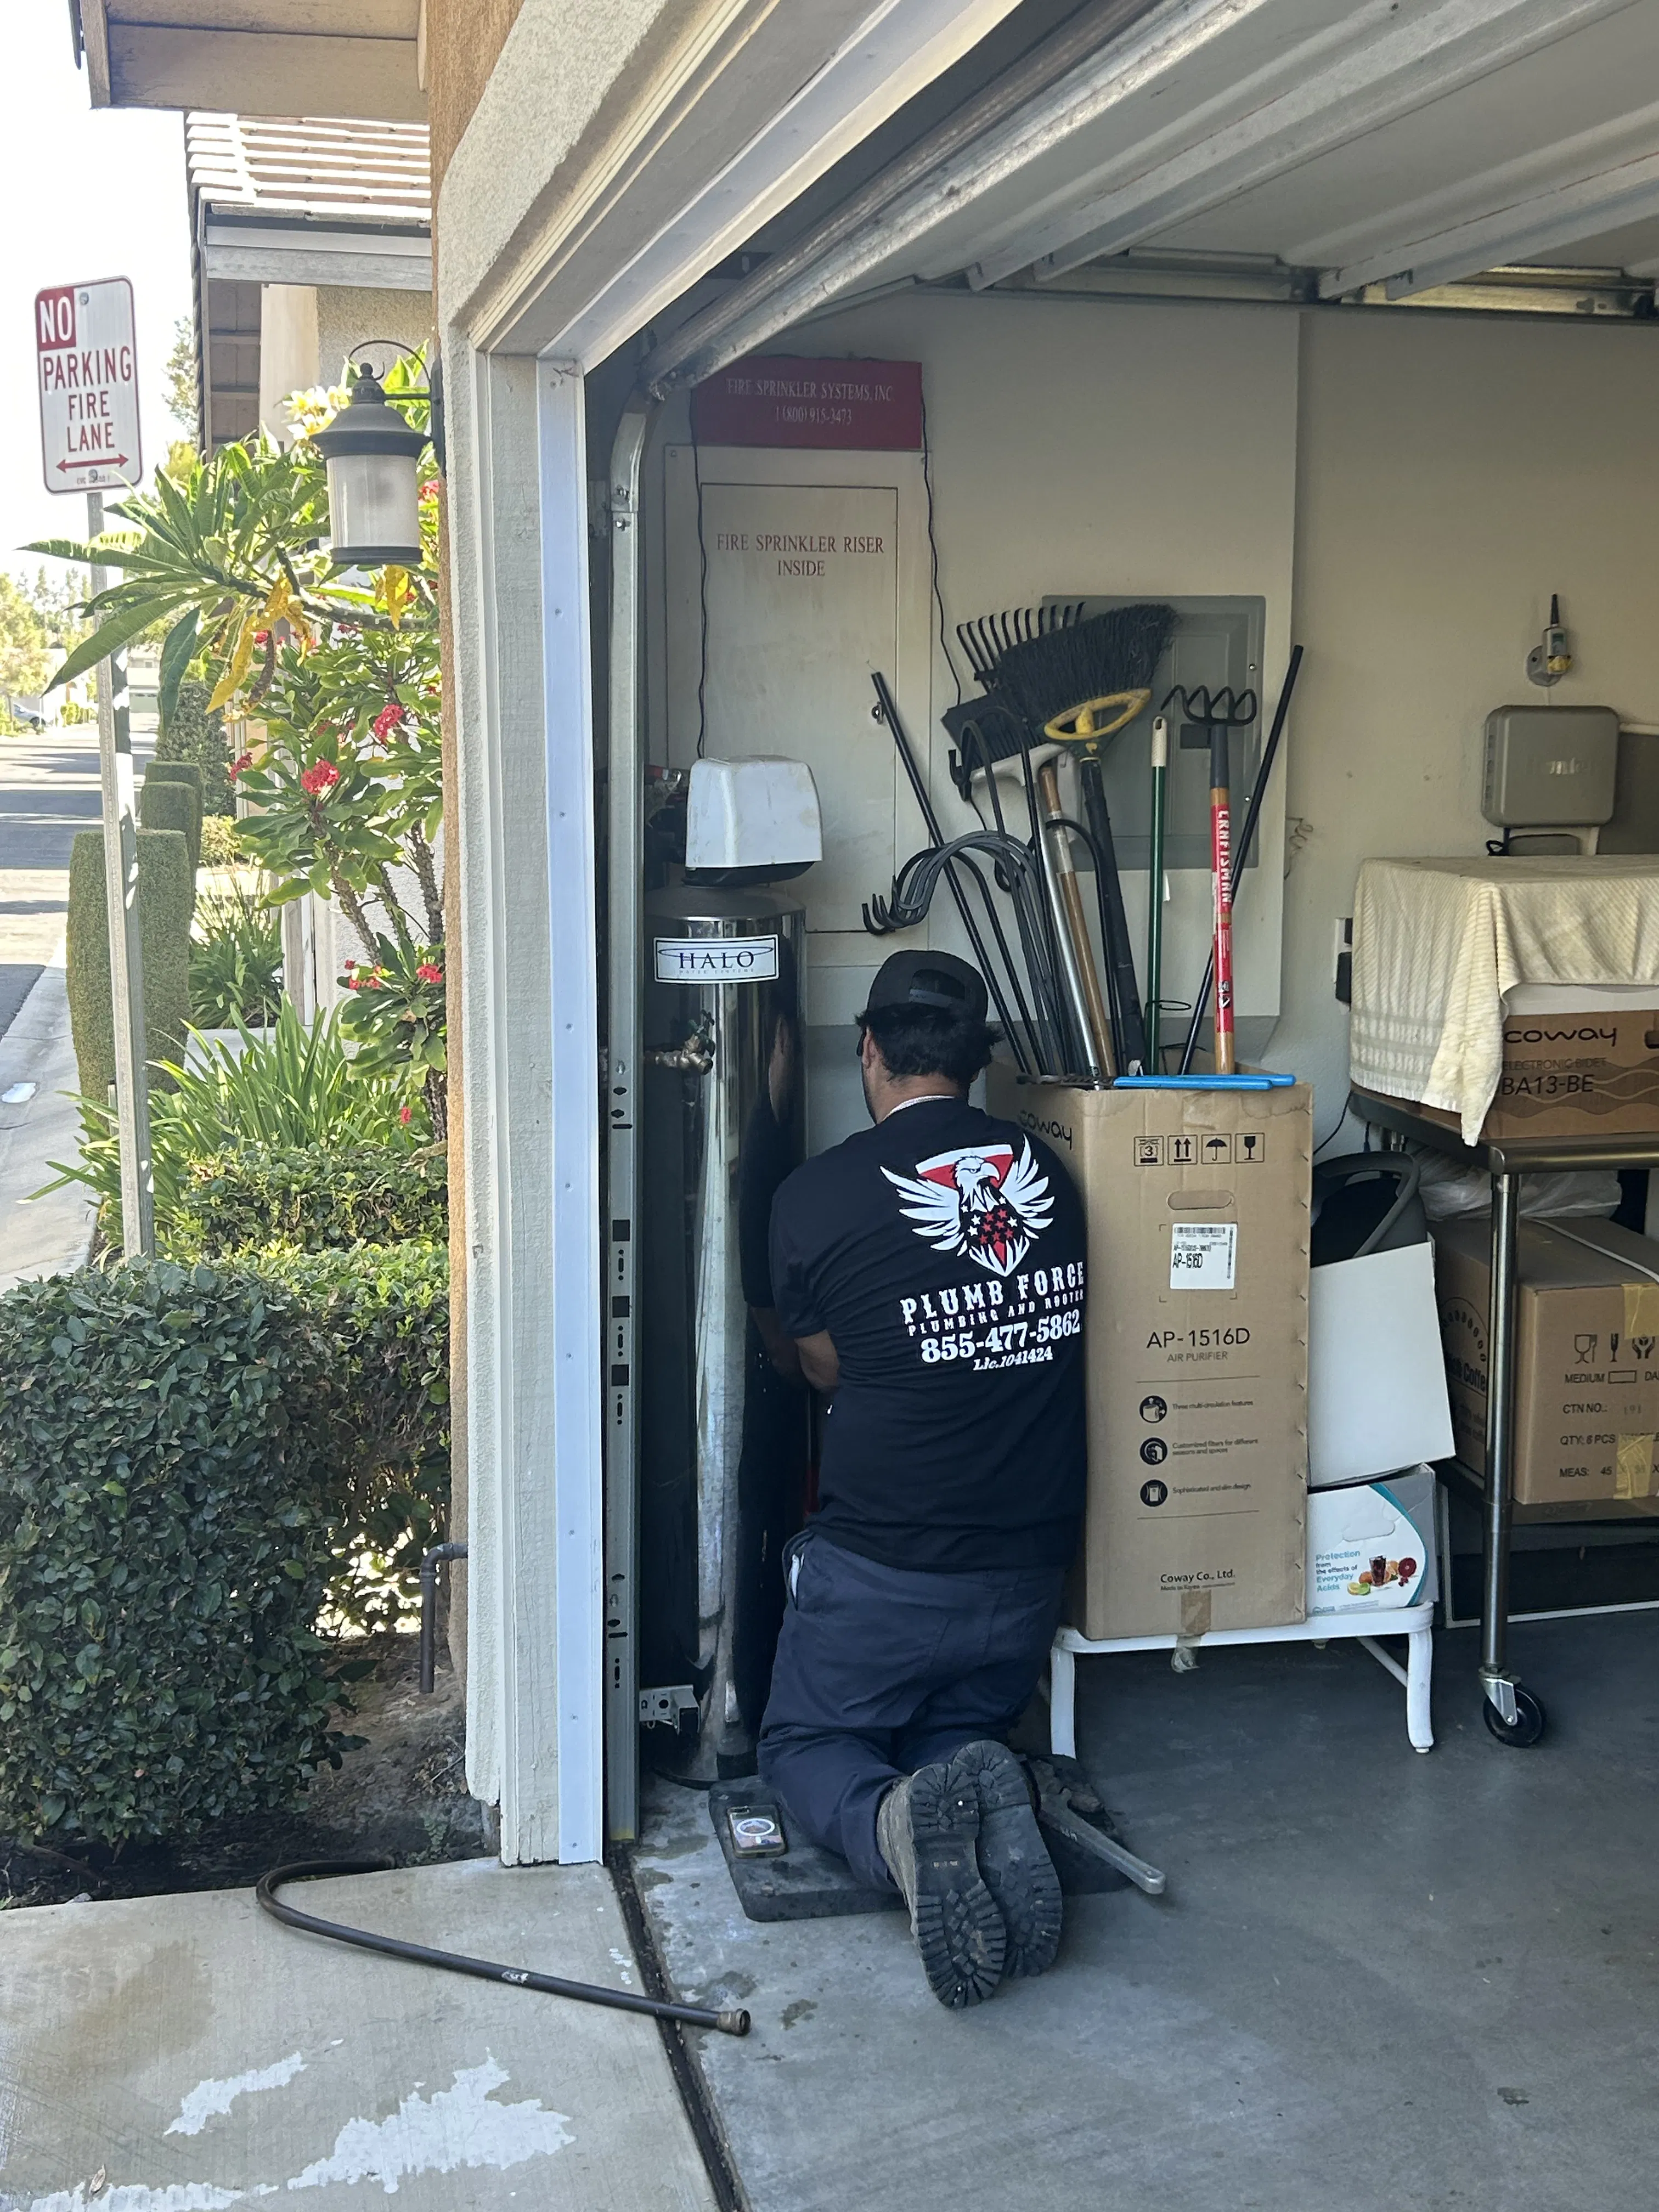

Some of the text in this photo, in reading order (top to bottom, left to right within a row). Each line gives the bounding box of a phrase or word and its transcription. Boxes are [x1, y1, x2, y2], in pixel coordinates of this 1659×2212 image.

[40, 296, 73, 344] NO
[43, 346, 132, 392] PARKING
[727, 379, 752, 396] FIRE
[756, 379, 817, 399] SPRINKLER
[68, 391, 110, 421] FIRE
[782, 405, 807, 424] (800)
[67, 422, 115, 453] LANE
[716, 533, 884, 554] FIRE SPRINKLER RISER
[777, 559, 826, 577] INSIDE
[1218, 810, 1232, 903] CRAFTSMAN
[679, 951, 754, 969] HALO
[1504, 1027, 1617, 1047] coway
[1503, 1057, 1607, 1070] ELECTRONIC BIDET
[1501, 1074, 1595, 1096] BA13-BE
[899, 1261, 1084, 1325] PLUMB FORCE
[907, 1289, 1084, 1337] PLUMBING AND ROOTER
[920, 1308, 1081, 1363] 855-477-5862
[1146, 1327, 1251, 1349] AP-1516D
[1166, 1351, 1228, 1363] AIR PURIFIER
[1463, 1362, 1486, 1393] Coffe
[1564, 1373, 1605, 1384] MEDIUM
[1562, 1403, 1584, 1414] CTN
[1594, 1434, 1616, 1444] PCS
[1559, 1467, 1589, 1477] MEAS:
[1600, 1466, 1612, 1476] 45
[1316, 1550, 1361, 1561] Protection
[1160, 1573, 1194, 1584] Coway
[1217, 1568, 1235, 1579] Ltd.
[1317, 1573, 1354, 1583] Everyday
[1317, 1583, 1340, 1592] Acids
